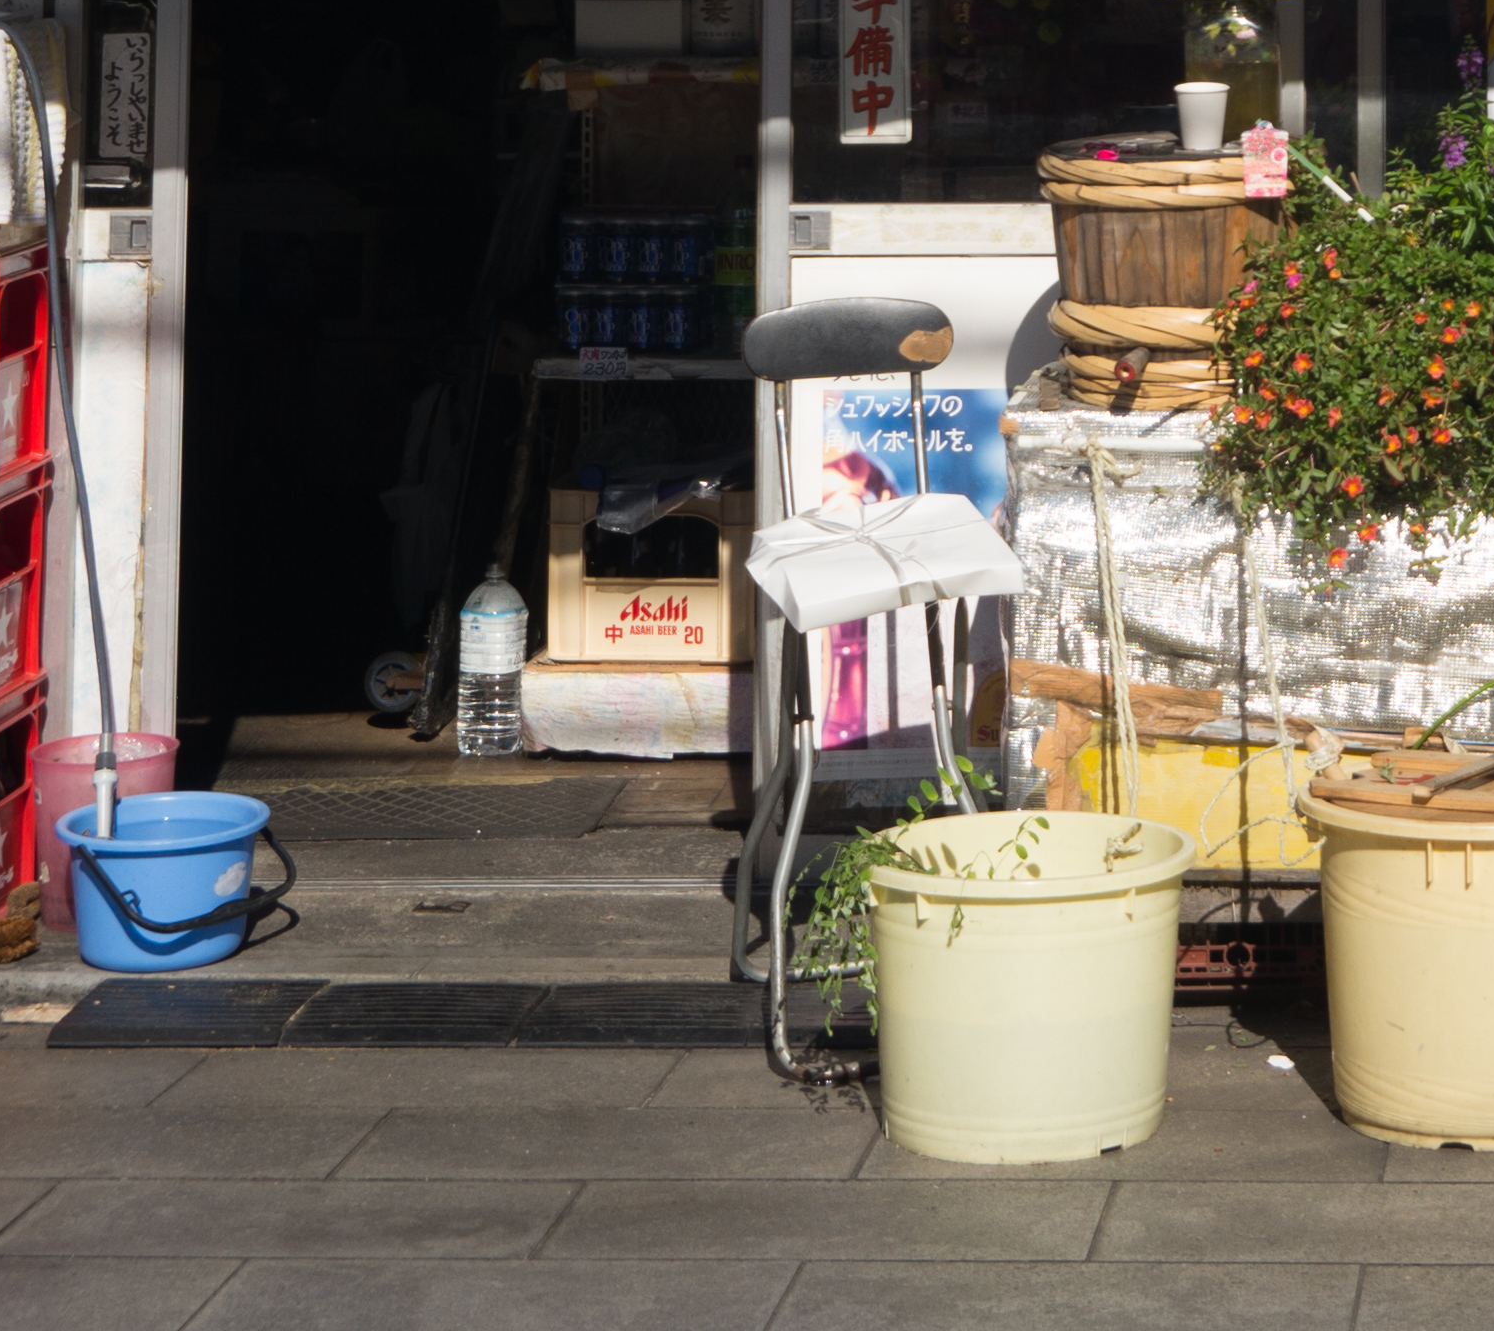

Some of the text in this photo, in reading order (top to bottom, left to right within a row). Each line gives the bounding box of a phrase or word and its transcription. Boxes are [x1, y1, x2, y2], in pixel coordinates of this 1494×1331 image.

[104, 62, 124, 146] ようこそ
[126, 37, 147, 154] いらっしゃいませ
[619, 595, 688, 623] Asahi
[605, 625, 623, 645] 中
[629, 625, 703, 645] ASAHI BEER 20
